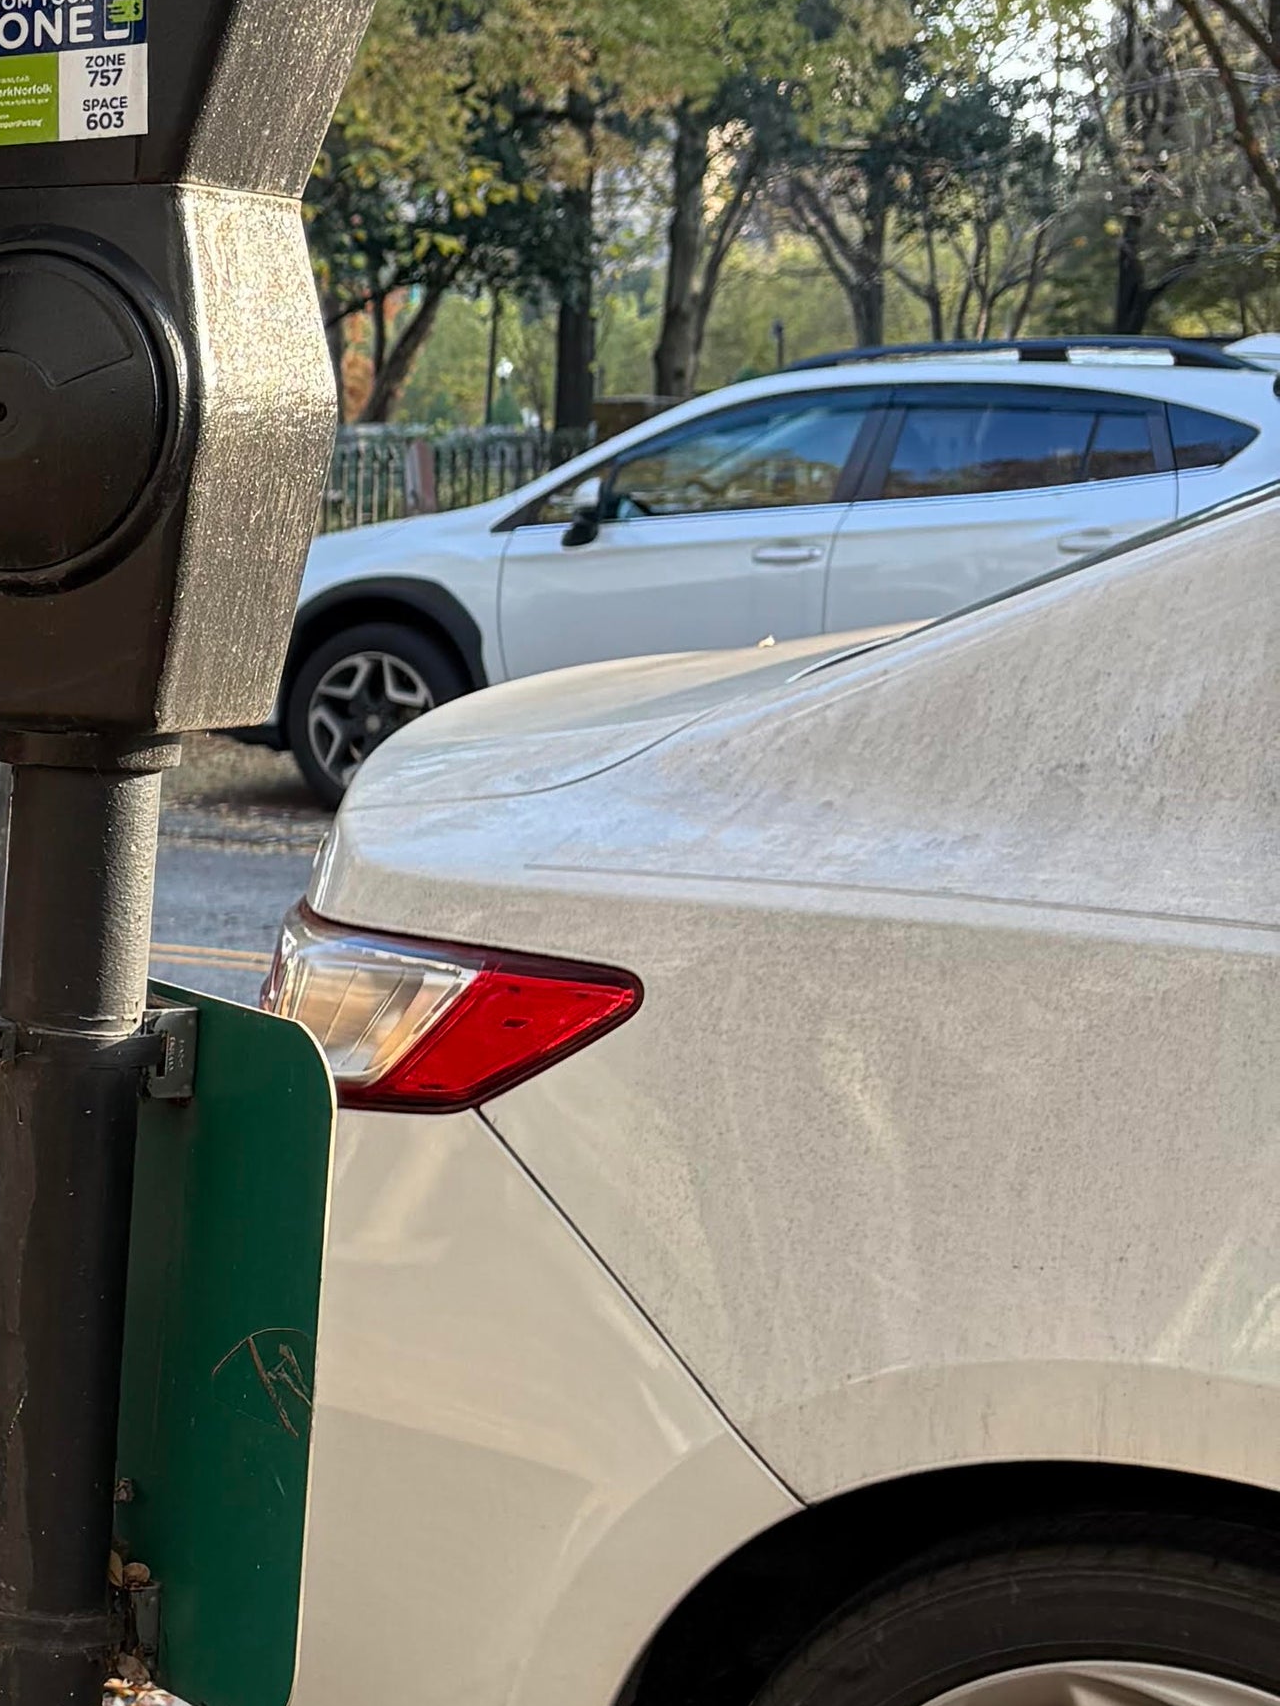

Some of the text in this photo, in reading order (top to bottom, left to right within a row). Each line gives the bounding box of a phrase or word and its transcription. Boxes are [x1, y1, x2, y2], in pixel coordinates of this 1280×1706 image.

[85, 53, 126, 68] ZONE
[88, 68, 123, 88] 757
[82, 96, 128, 112] SPACE
[86, 112, 124, 131] 603
